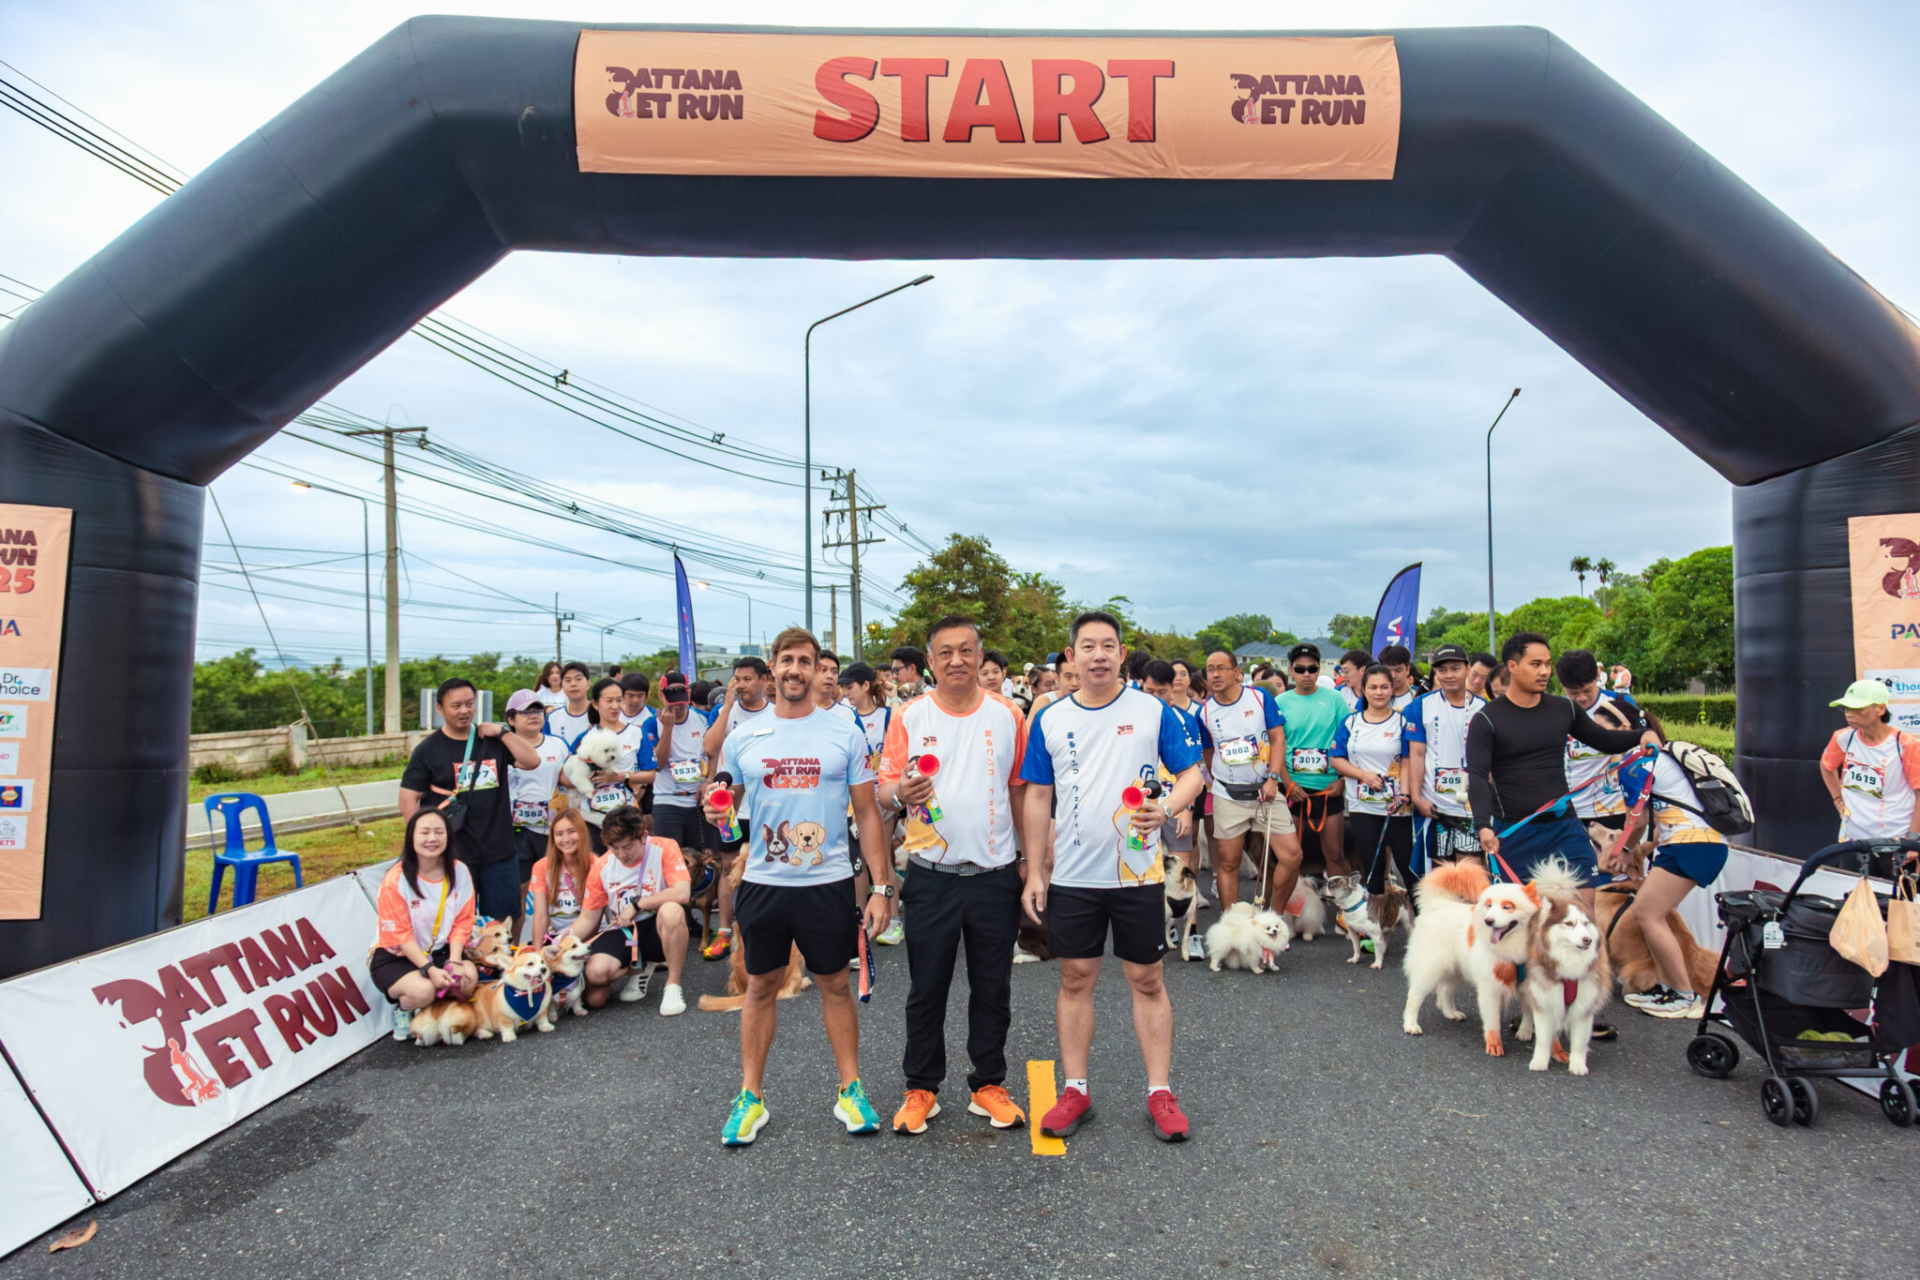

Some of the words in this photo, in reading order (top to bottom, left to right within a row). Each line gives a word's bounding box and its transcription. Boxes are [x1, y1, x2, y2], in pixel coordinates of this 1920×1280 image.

[813, 56, 1174, 143] START
[678, 93, 744, 121] RUN
[1301, 99, 1366, 126] RUN
[1225, 746, 1250, 756] 3002
[1298, 756, 1321, 764] 3017
[673, 766, 697, 776] 3535
[796, 766, 821, 776] RUN
[1850, 770, 1877, 786] 1619
[595, 792, 620, 803] 3581
[518, 809, 543, 818] 3582
[263, 965, 371, 1054] RUN
